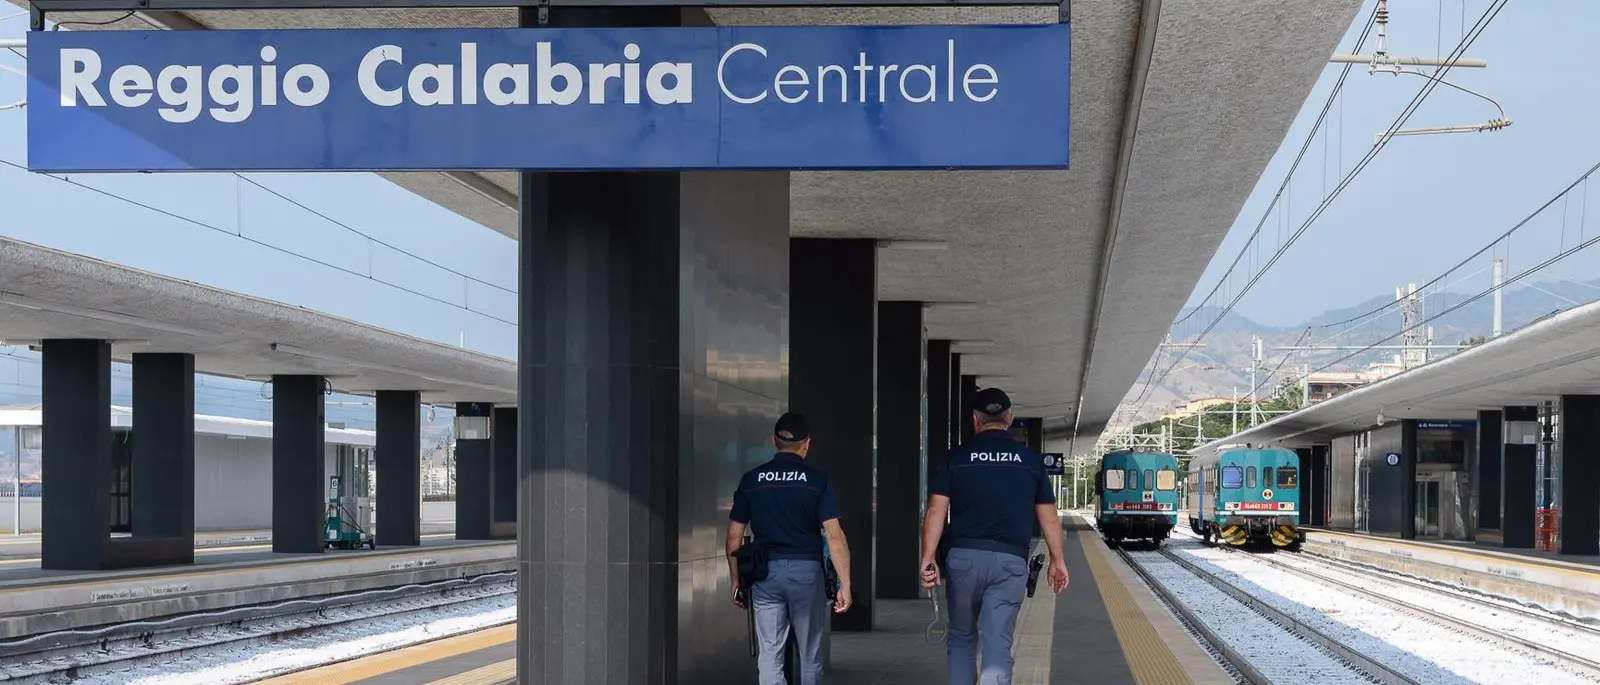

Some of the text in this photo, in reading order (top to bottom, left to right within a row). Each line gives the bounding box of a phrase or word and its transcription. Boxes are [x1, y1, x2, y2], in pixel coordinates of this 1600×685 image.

[60, 39, 1000, 123] Reggio Calabria Centrale
[970, 452, 1022, 464] POLIZIA
[757, 470, 808, 483] POLIZIA
